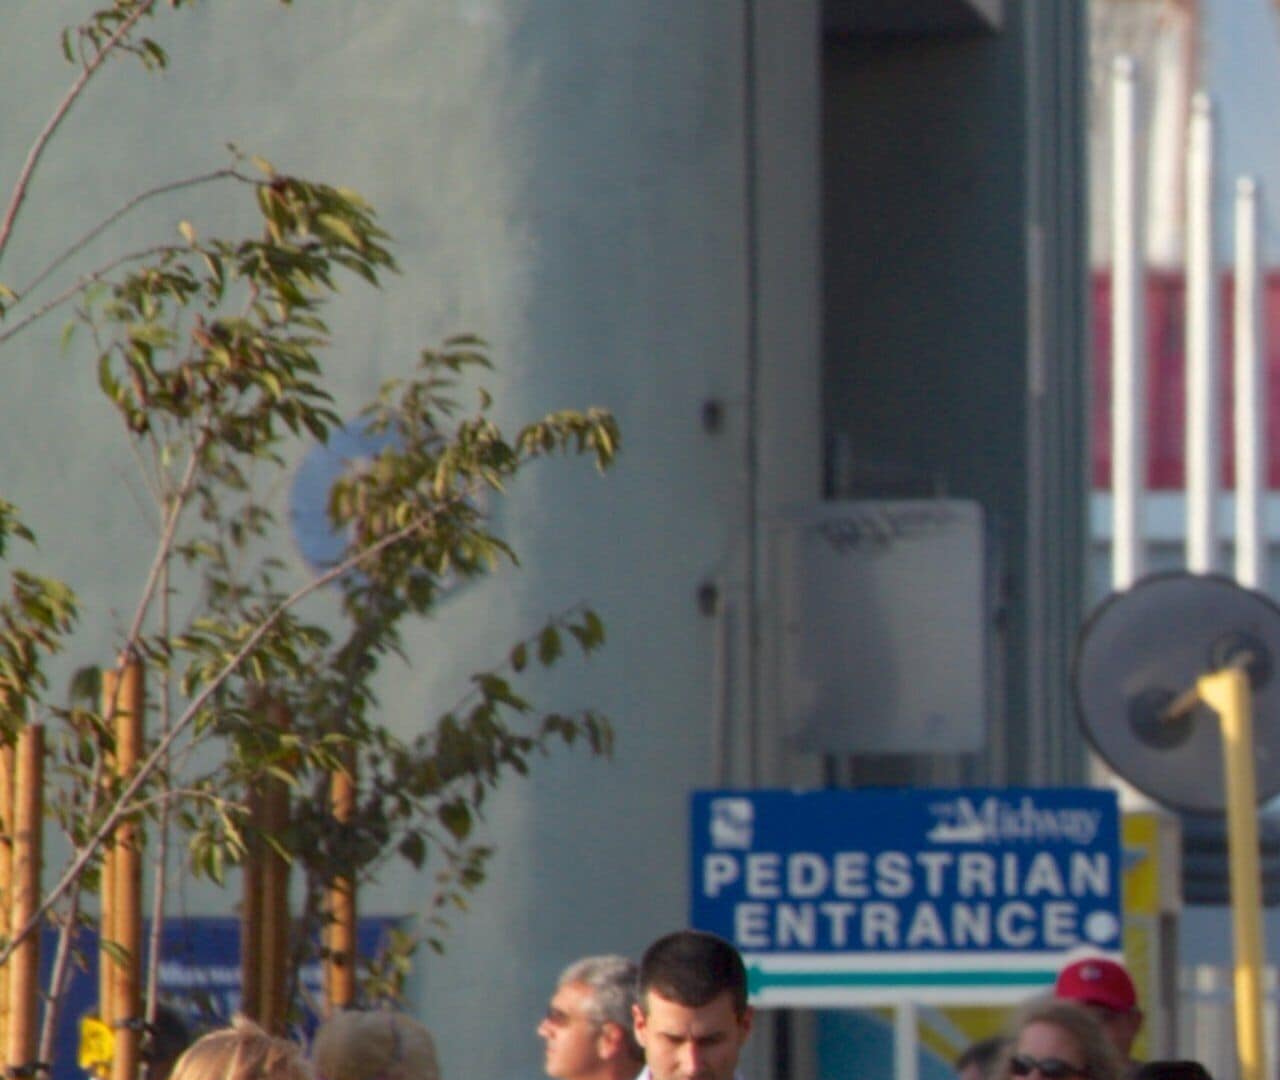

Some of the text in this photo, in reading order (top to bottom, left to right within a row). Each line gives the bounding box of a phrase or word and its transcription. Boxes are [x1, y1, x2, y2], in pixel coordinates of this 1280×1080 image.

[956, 796, 1100, 846] Midway
[704, 851, 1109, 898] PEDESTRIAN
[735, 902, 1079, 947] ENTRANCE
